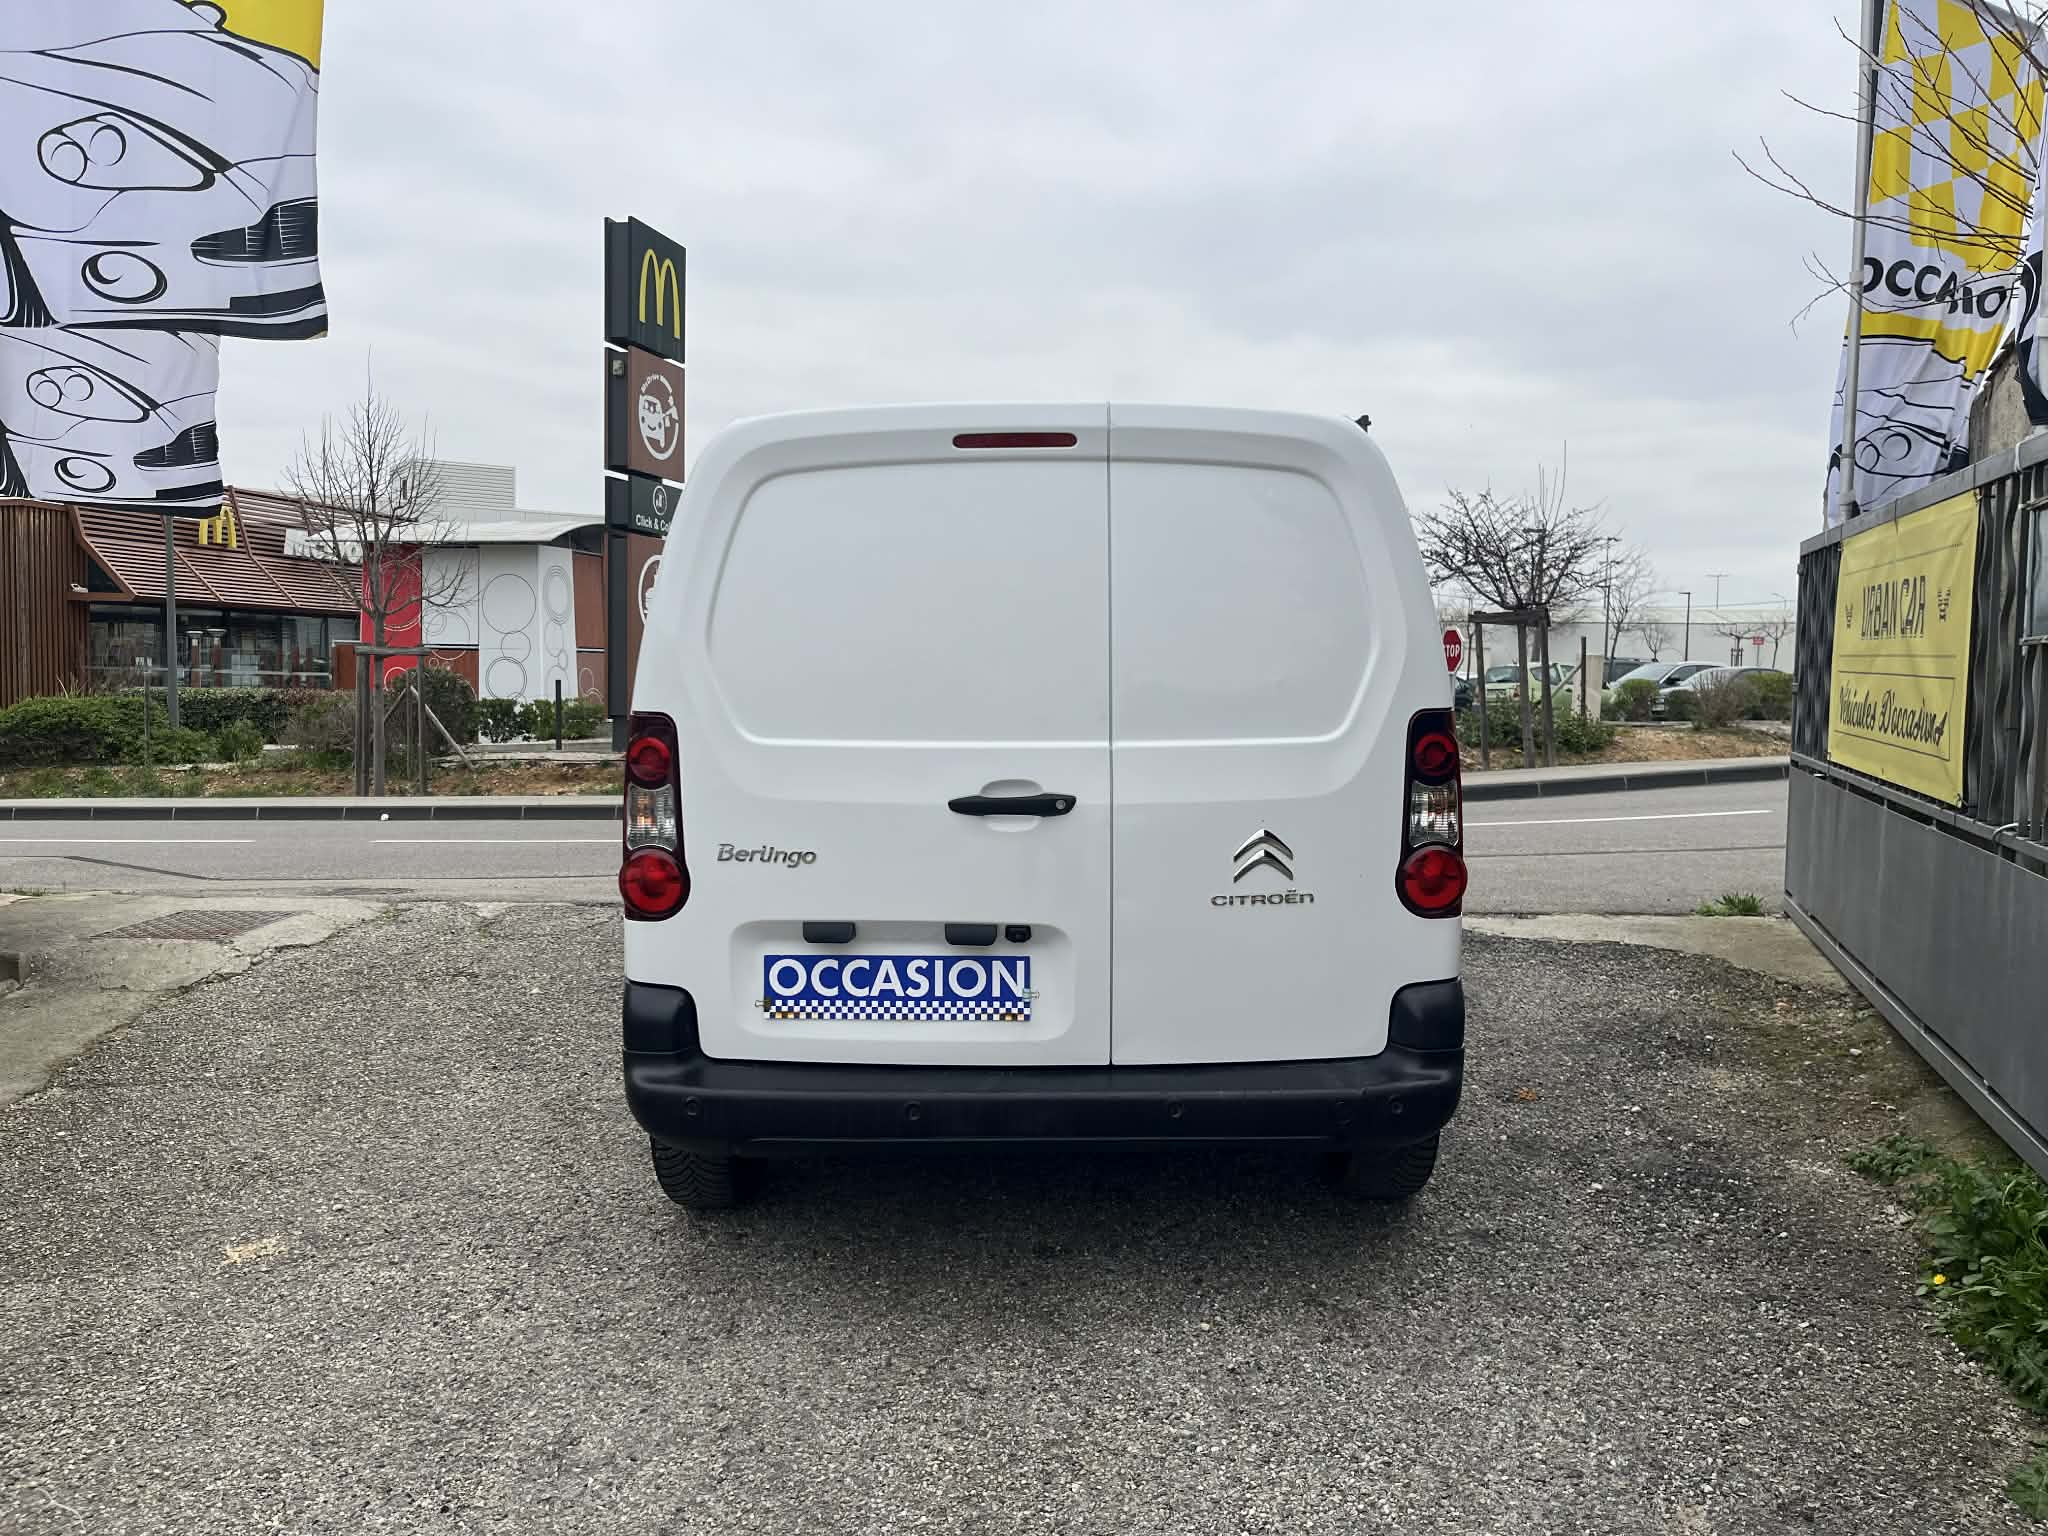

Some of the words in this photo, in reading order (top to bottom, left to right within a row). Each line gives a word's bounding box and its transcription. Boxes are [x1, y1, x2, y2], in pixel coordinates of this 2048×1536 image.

[635, 514, 653, 529] Click
[654, 518, 660, 530] &
[1861, 580, 1898, 640] URBAN
[1900, 576, 1926, 638] CAR
[1446, 644, 1461, 658] TOP
[1840, 680, 1877, 731] Véhicules
[717, 843, 817, 868] Berlingo
[768, 958, 1027, 998] OCCASION
